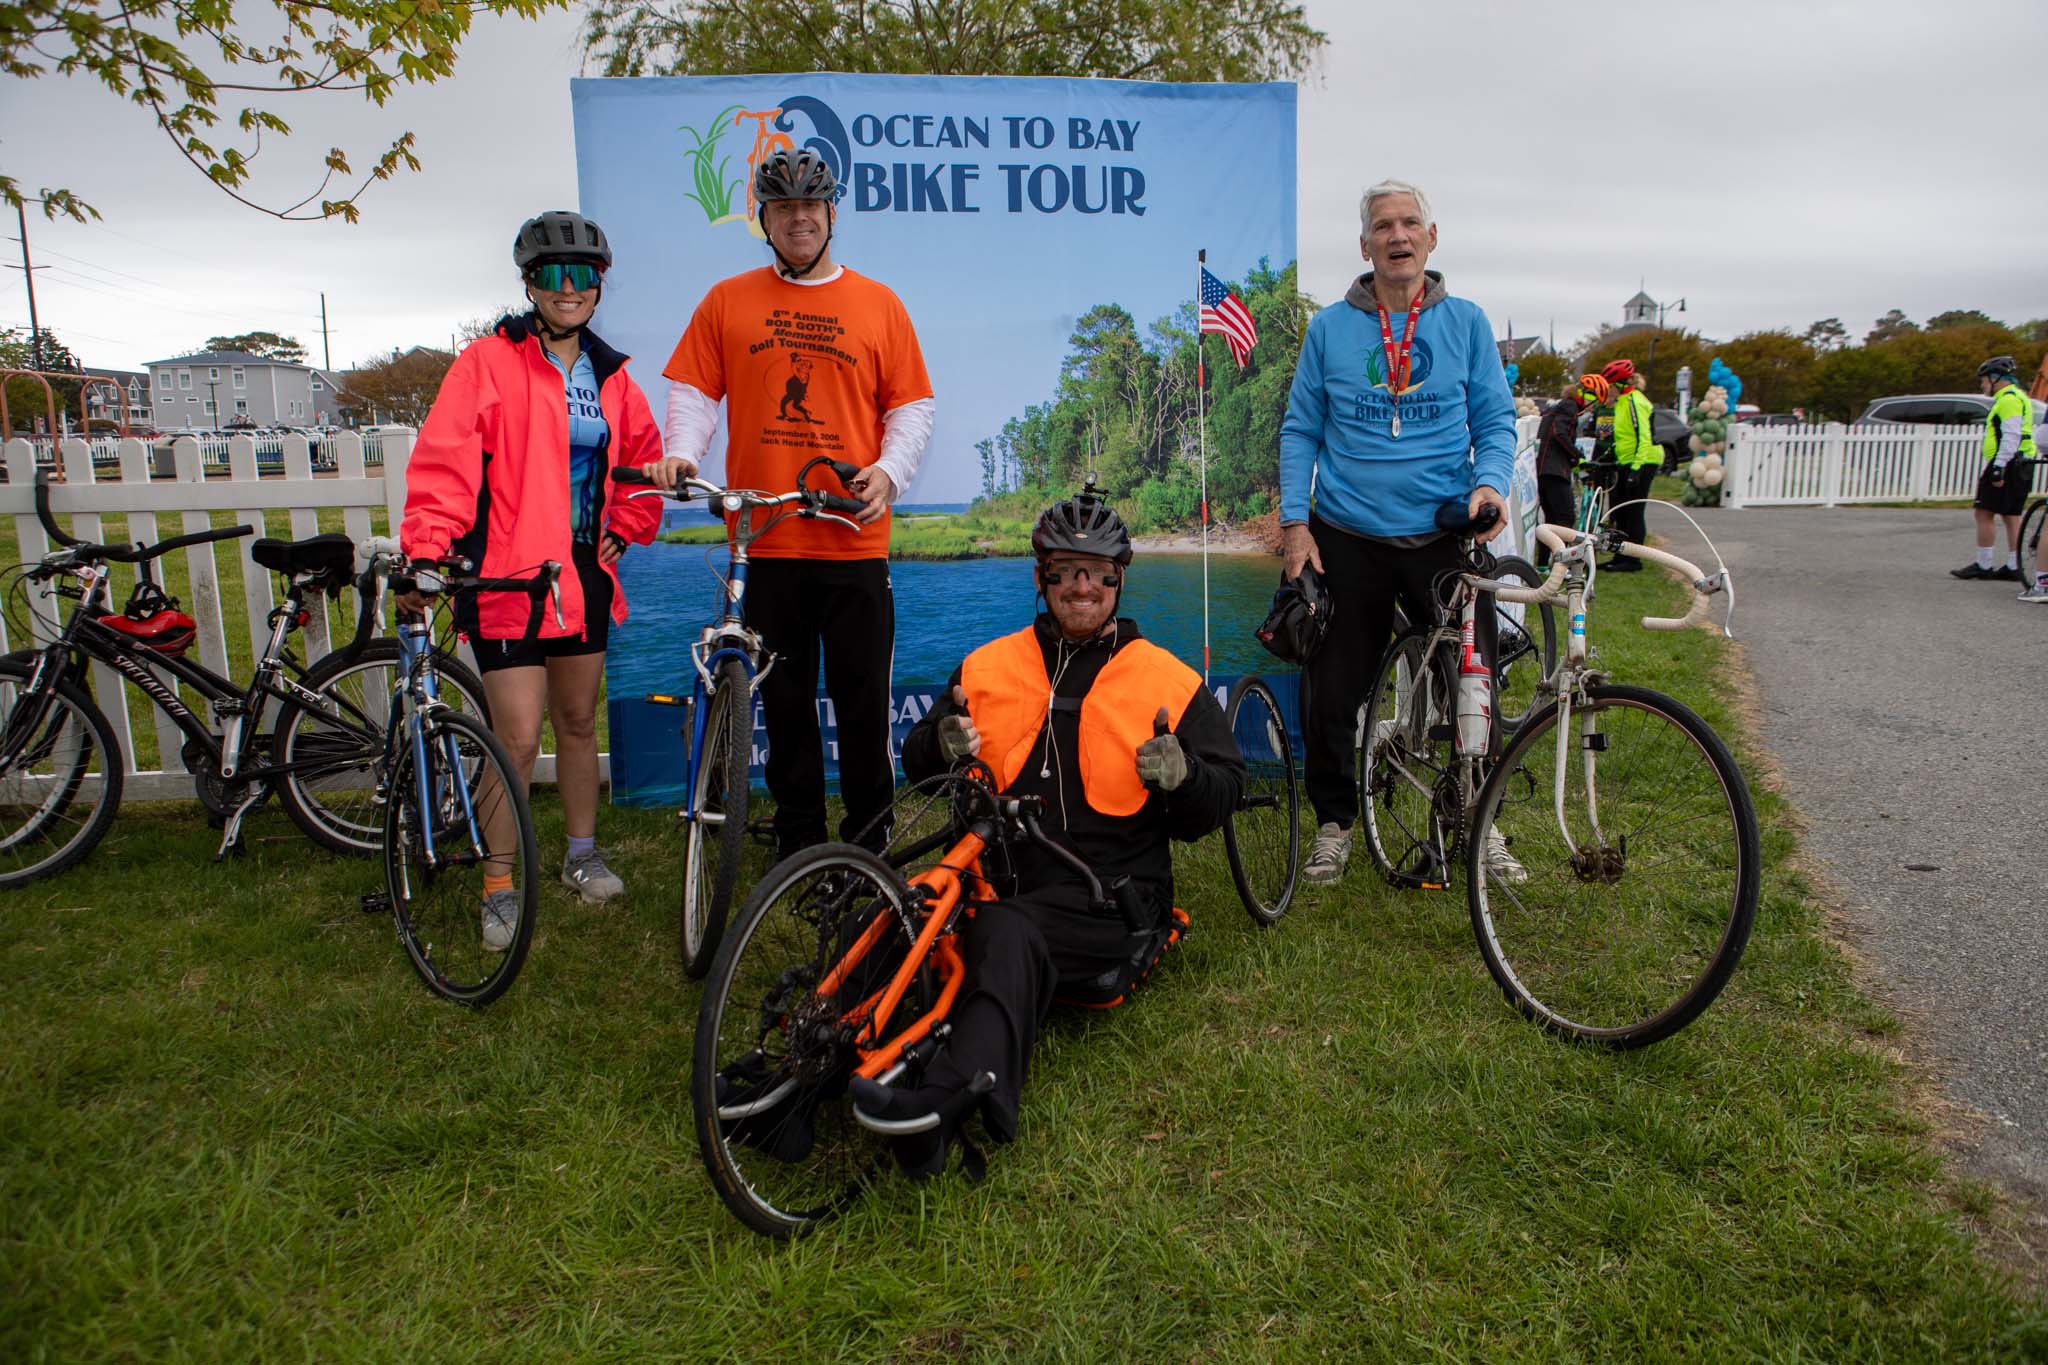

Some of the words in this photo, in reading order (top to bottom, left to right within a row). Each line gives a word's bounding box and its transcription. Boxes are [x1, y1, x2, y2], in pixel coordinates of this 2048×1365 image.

[852, 114, 989, 149] OCEAN
[1003, 116, 1055, 149] TO
[1068, 117, 1141, 151] BAY
[854, 162, 980, 213] BIKE
[998, 163, 1147, 216] TOUR
[793, 311, 839, 324] Annual
[765, 318, 793, 328] BOB
[796, 322, 845, 335] GOTH'S
[773, 327, 837, 343] Memorial
[749, 338, 775, 355] Golf
[778, 337, 858, 368] Tournament
[573, 387, 596, 402] TO
[1355, 393, 1394, 405] OCEAN
[1416, 391, 1440, 403] BAY
[1354, 406, 1393, 420] BIKE
[1398, 404, 1441, 420] TOUR
[114, 655, 189, 717] SPECIALIZED
